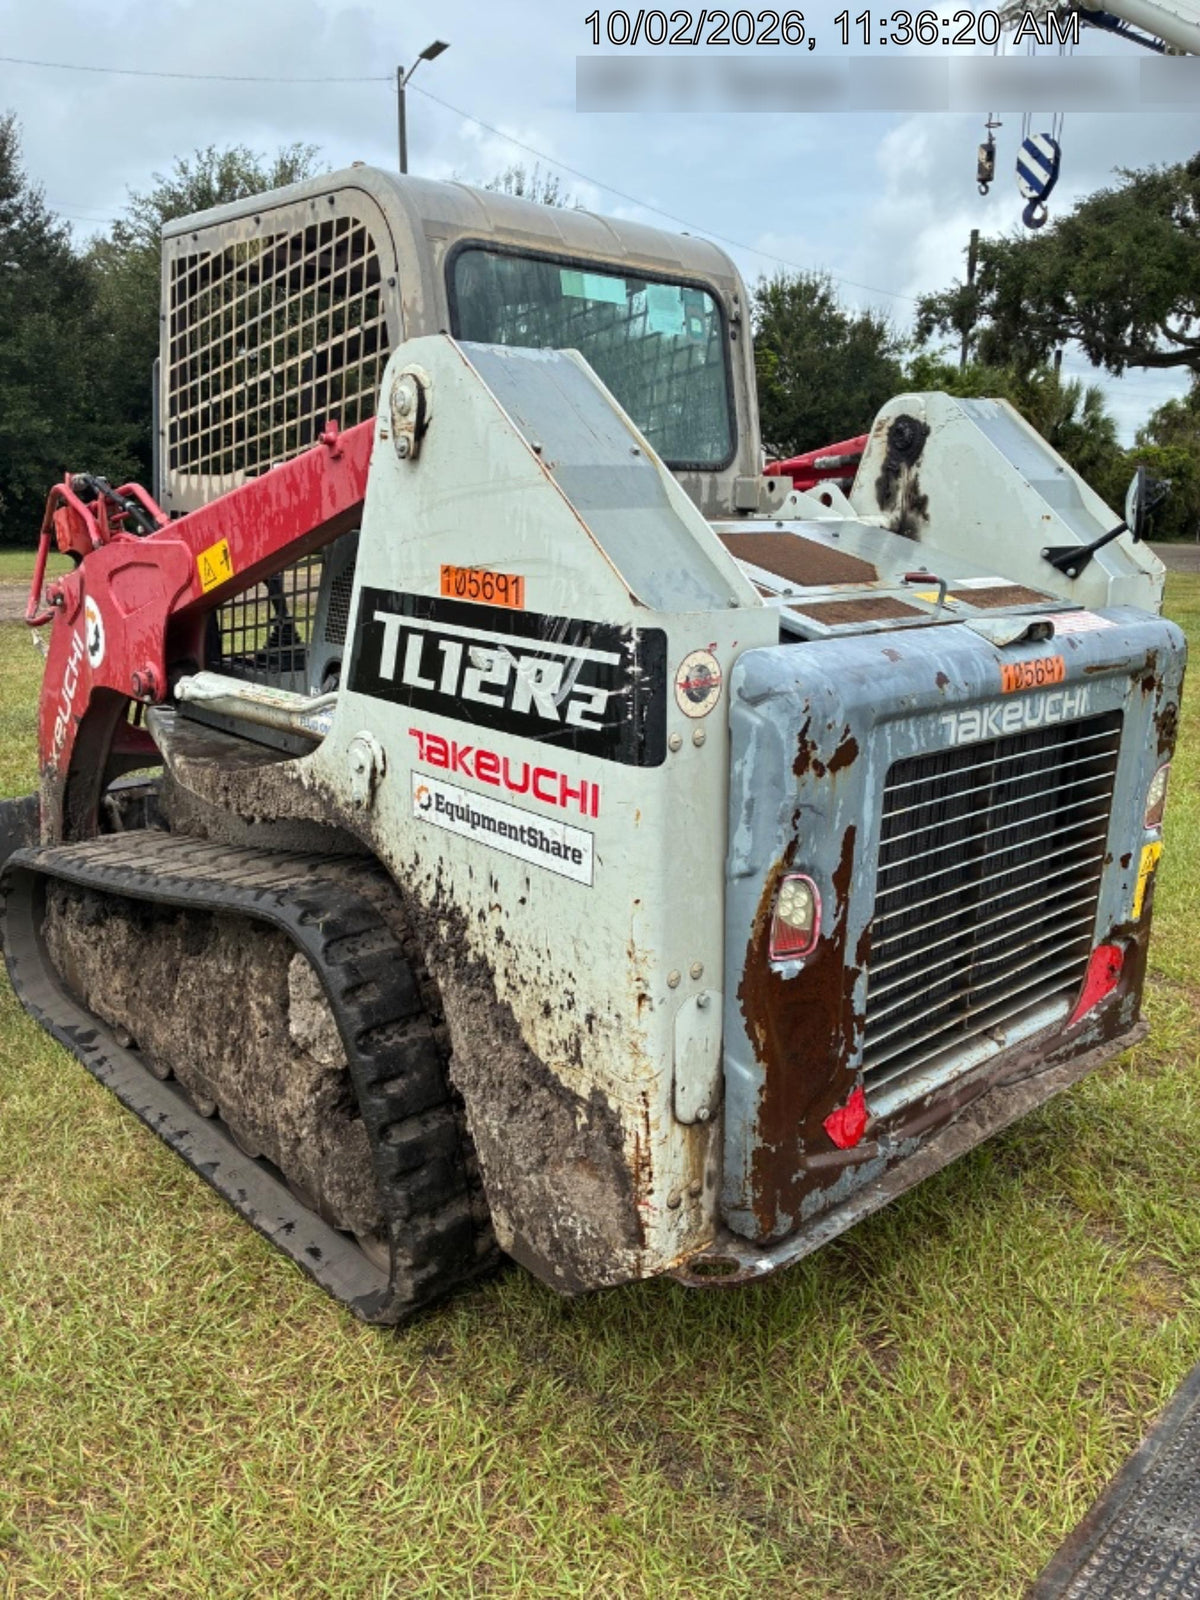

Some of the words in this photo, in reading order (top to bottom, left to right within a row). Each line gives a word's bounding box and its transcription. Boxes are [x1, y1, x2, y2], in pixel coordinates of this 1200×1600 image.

[443, 565, 520, 605] 105691
[940, 687, 1087, 745] TAKEUCHI
[408, 728, 599, 818] TAKEUCHI
[434, 792, 583, 865] EquipmentShare
